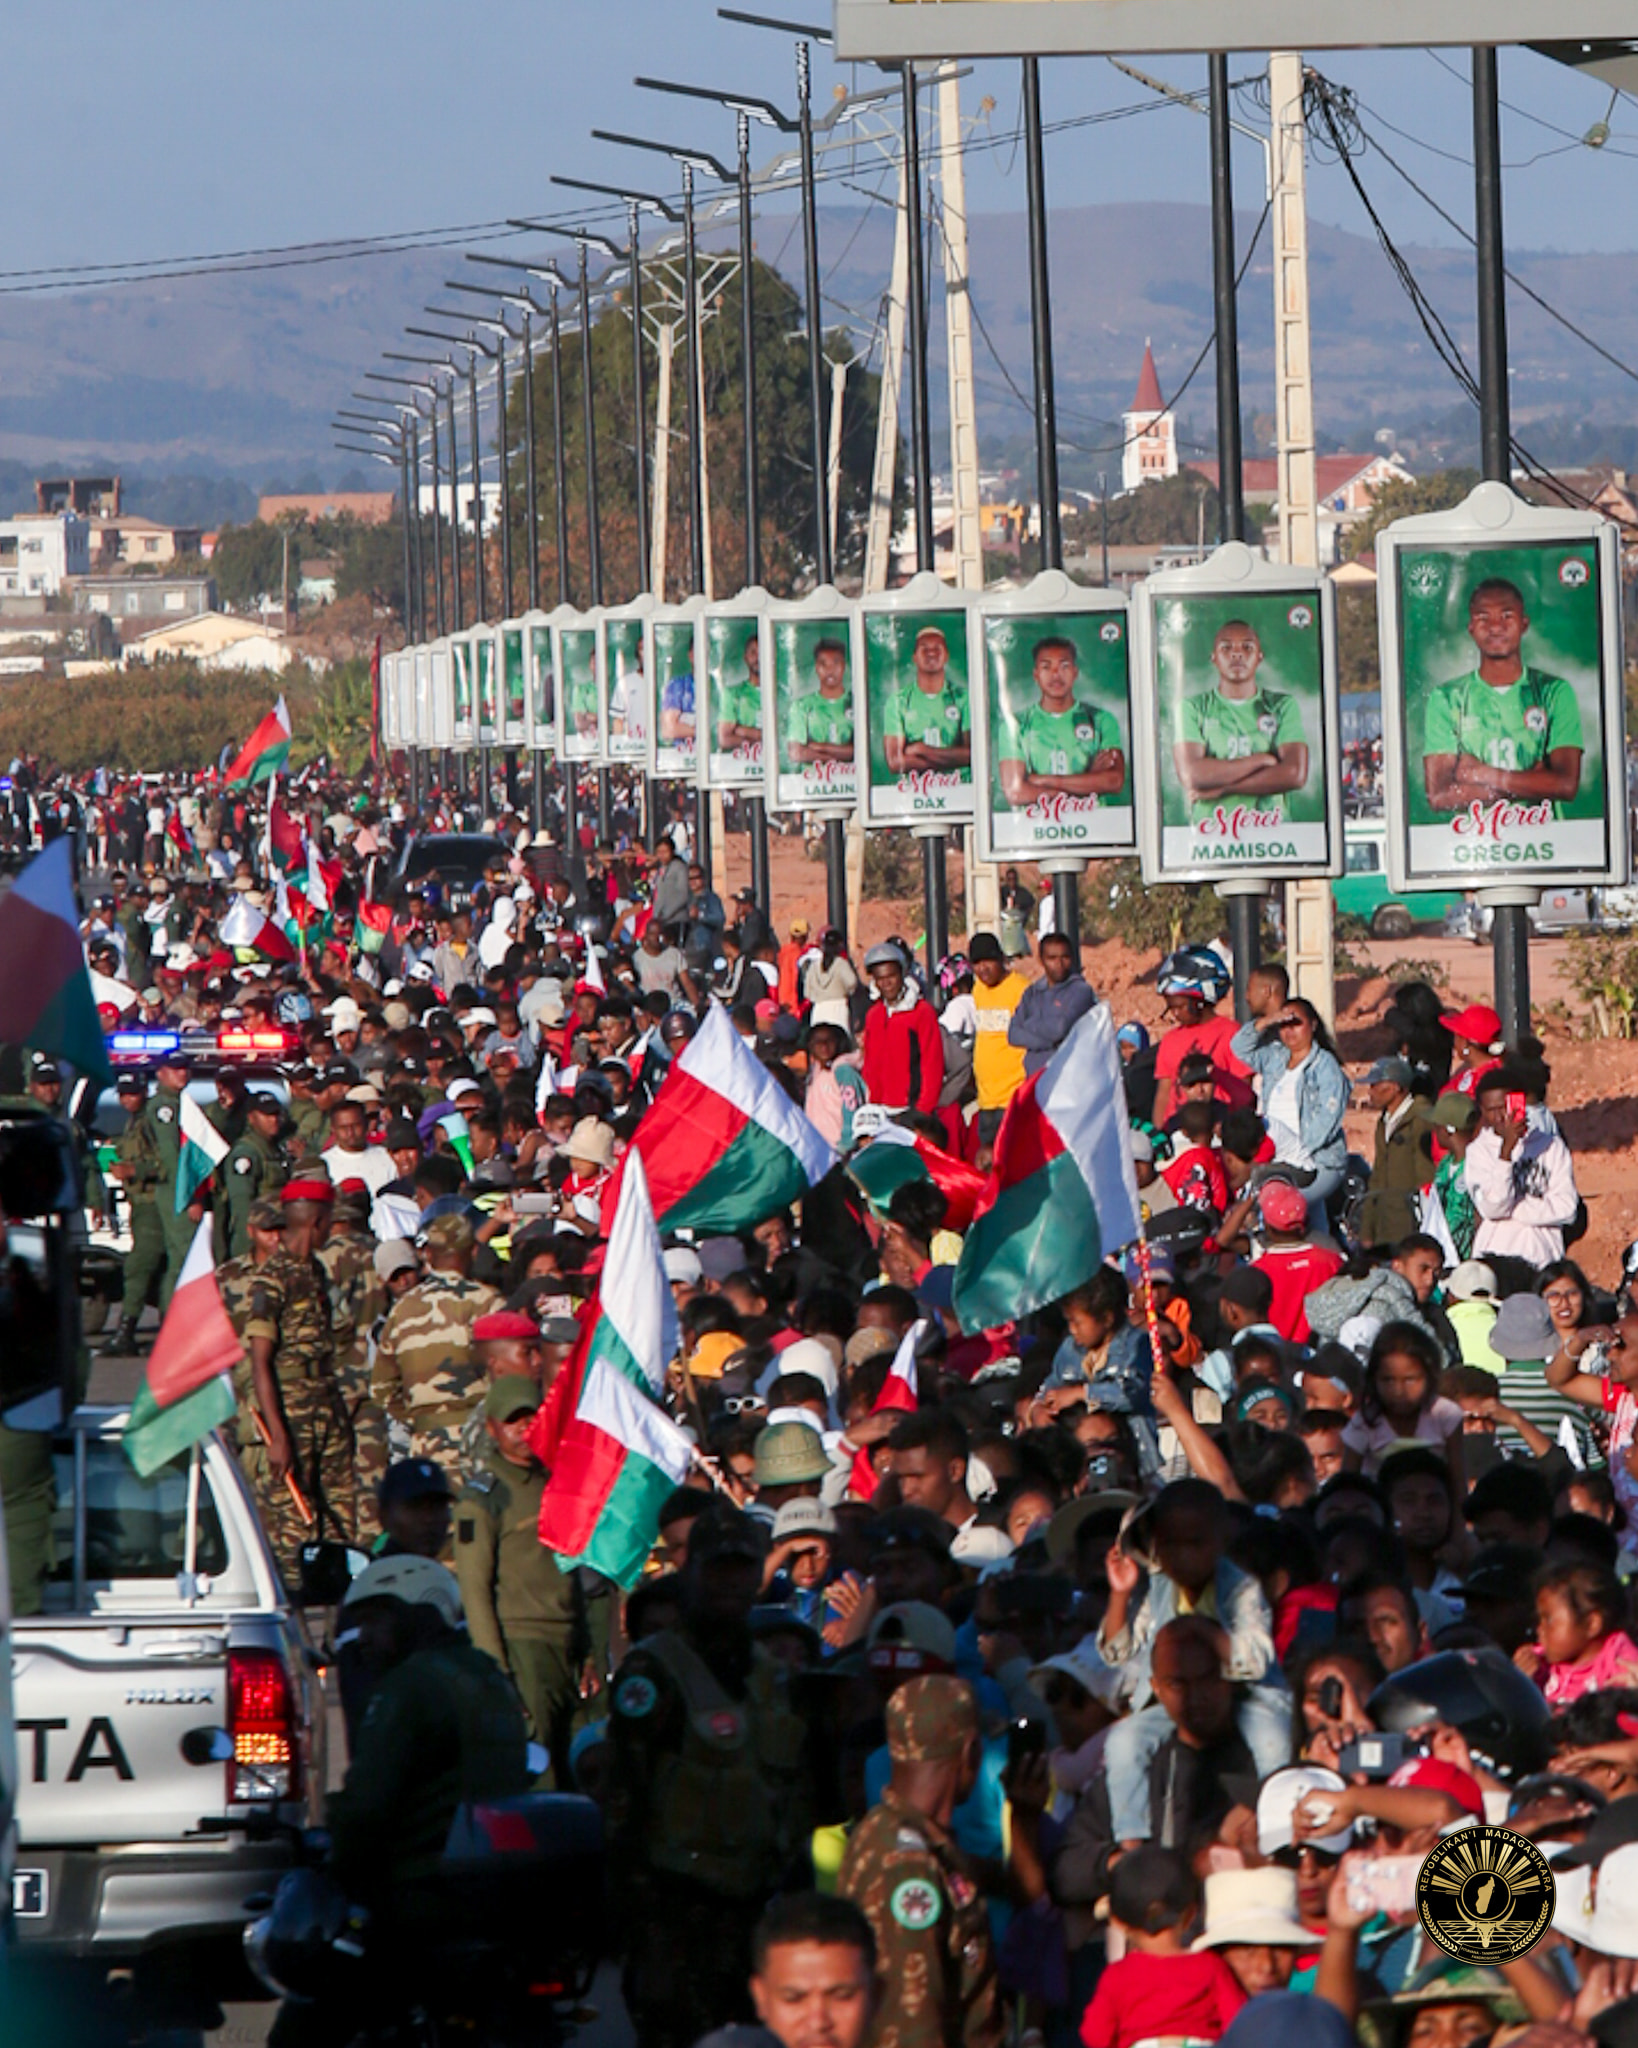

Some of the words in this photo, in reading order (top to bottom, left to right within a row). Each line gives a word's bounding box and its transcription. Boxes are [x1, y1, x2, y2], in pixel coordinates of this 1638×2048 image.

[897, 769, 961, 798] Merci
[913, 797, 946, 809] DAX
[1026, 792, 1098, 823] Merci
[1034, 825, 1088, 839] BONO
[1198, 805, 1282, 840] Merci
[1452, 799, 1551, 841] Merci
[1191, 842, 1298, 860] MAMISOA
[1453, 842, 1555, 863] GREGAS
